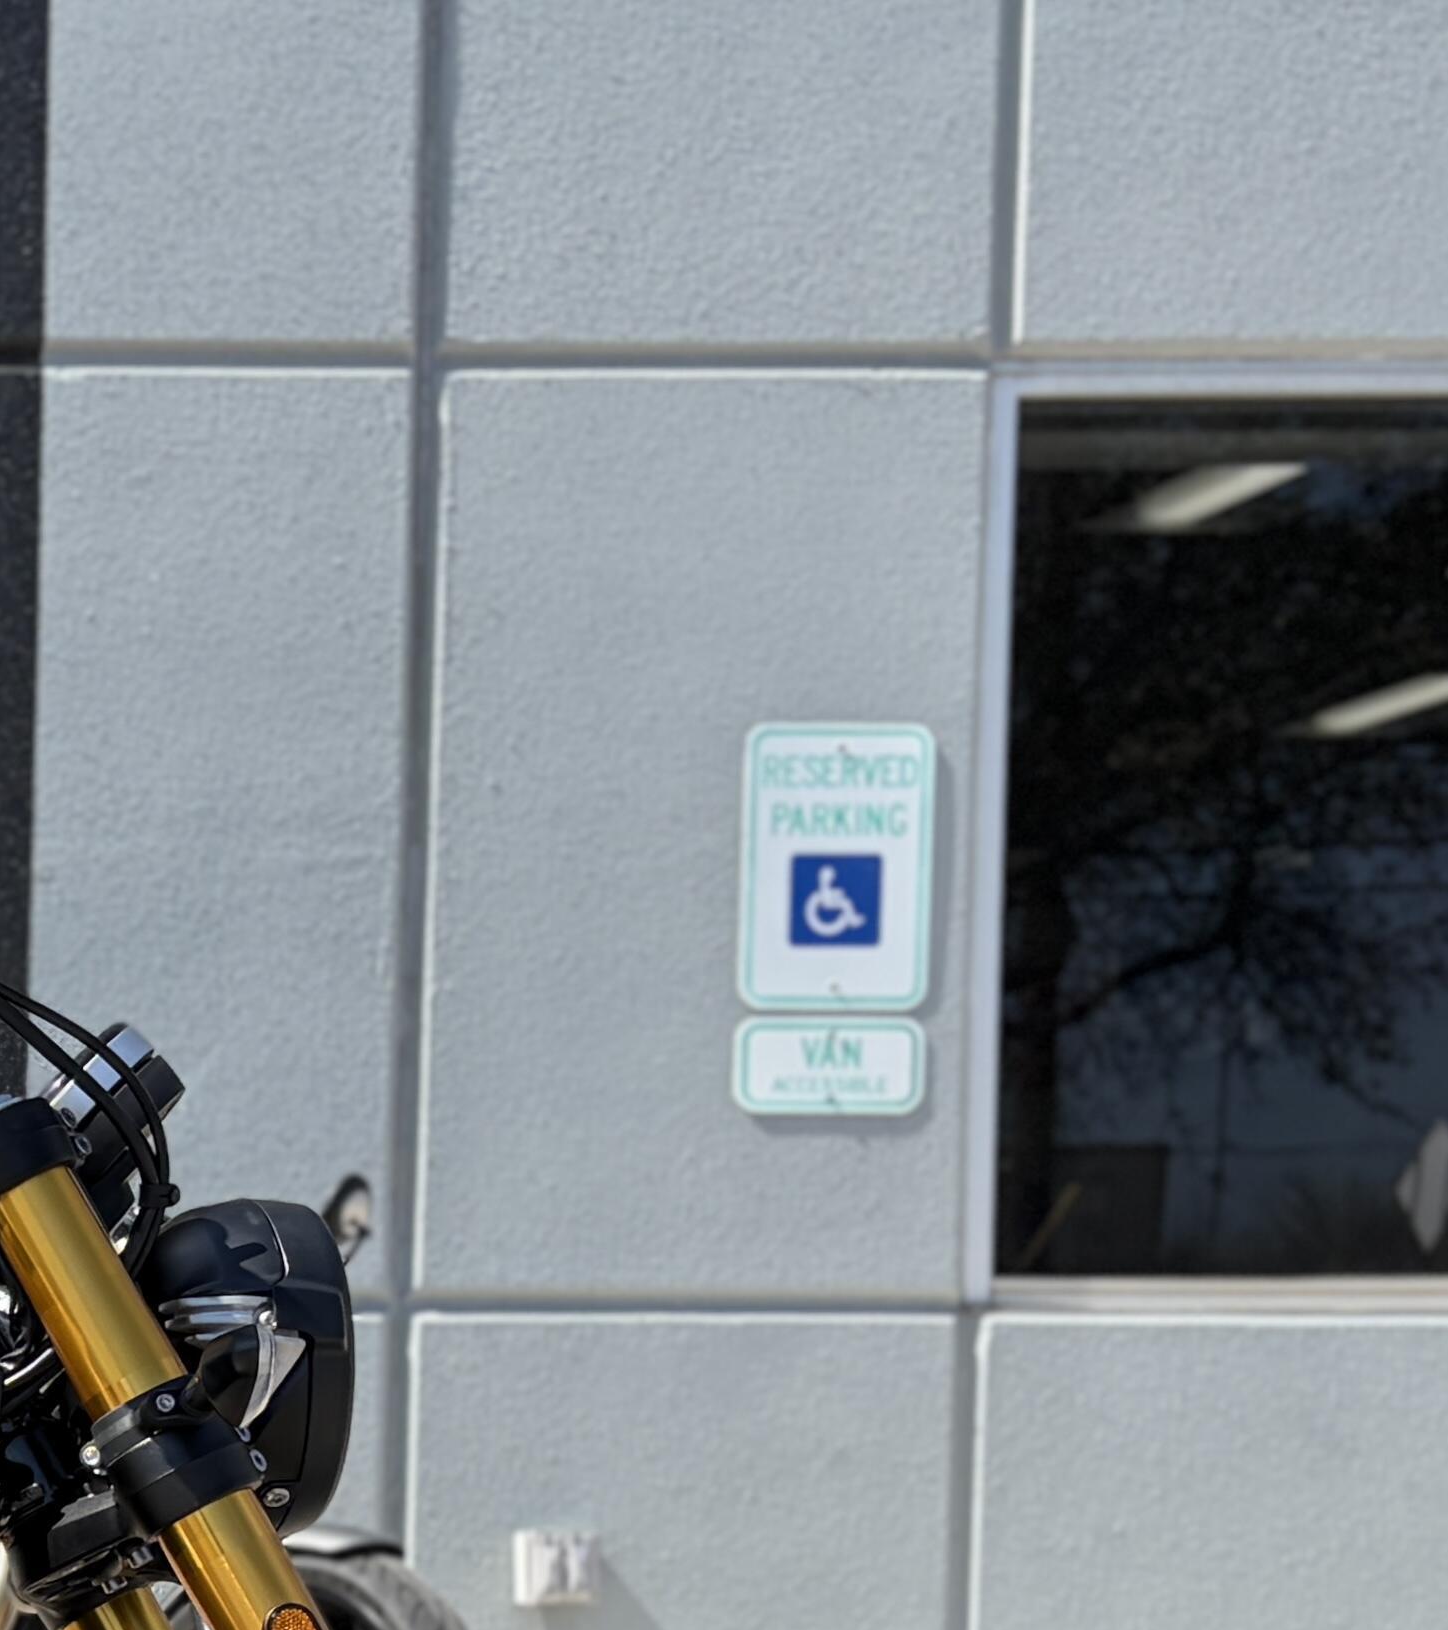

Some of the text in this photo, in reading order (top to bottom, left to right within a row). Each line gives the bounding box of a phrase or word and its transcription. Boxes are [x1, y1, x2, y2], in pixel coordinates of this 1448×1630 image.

[759, 753, 920, 788] RESERVED
[770, 802, 909, 837] PARKING
[800, 1035, 863, 1070] VAN
